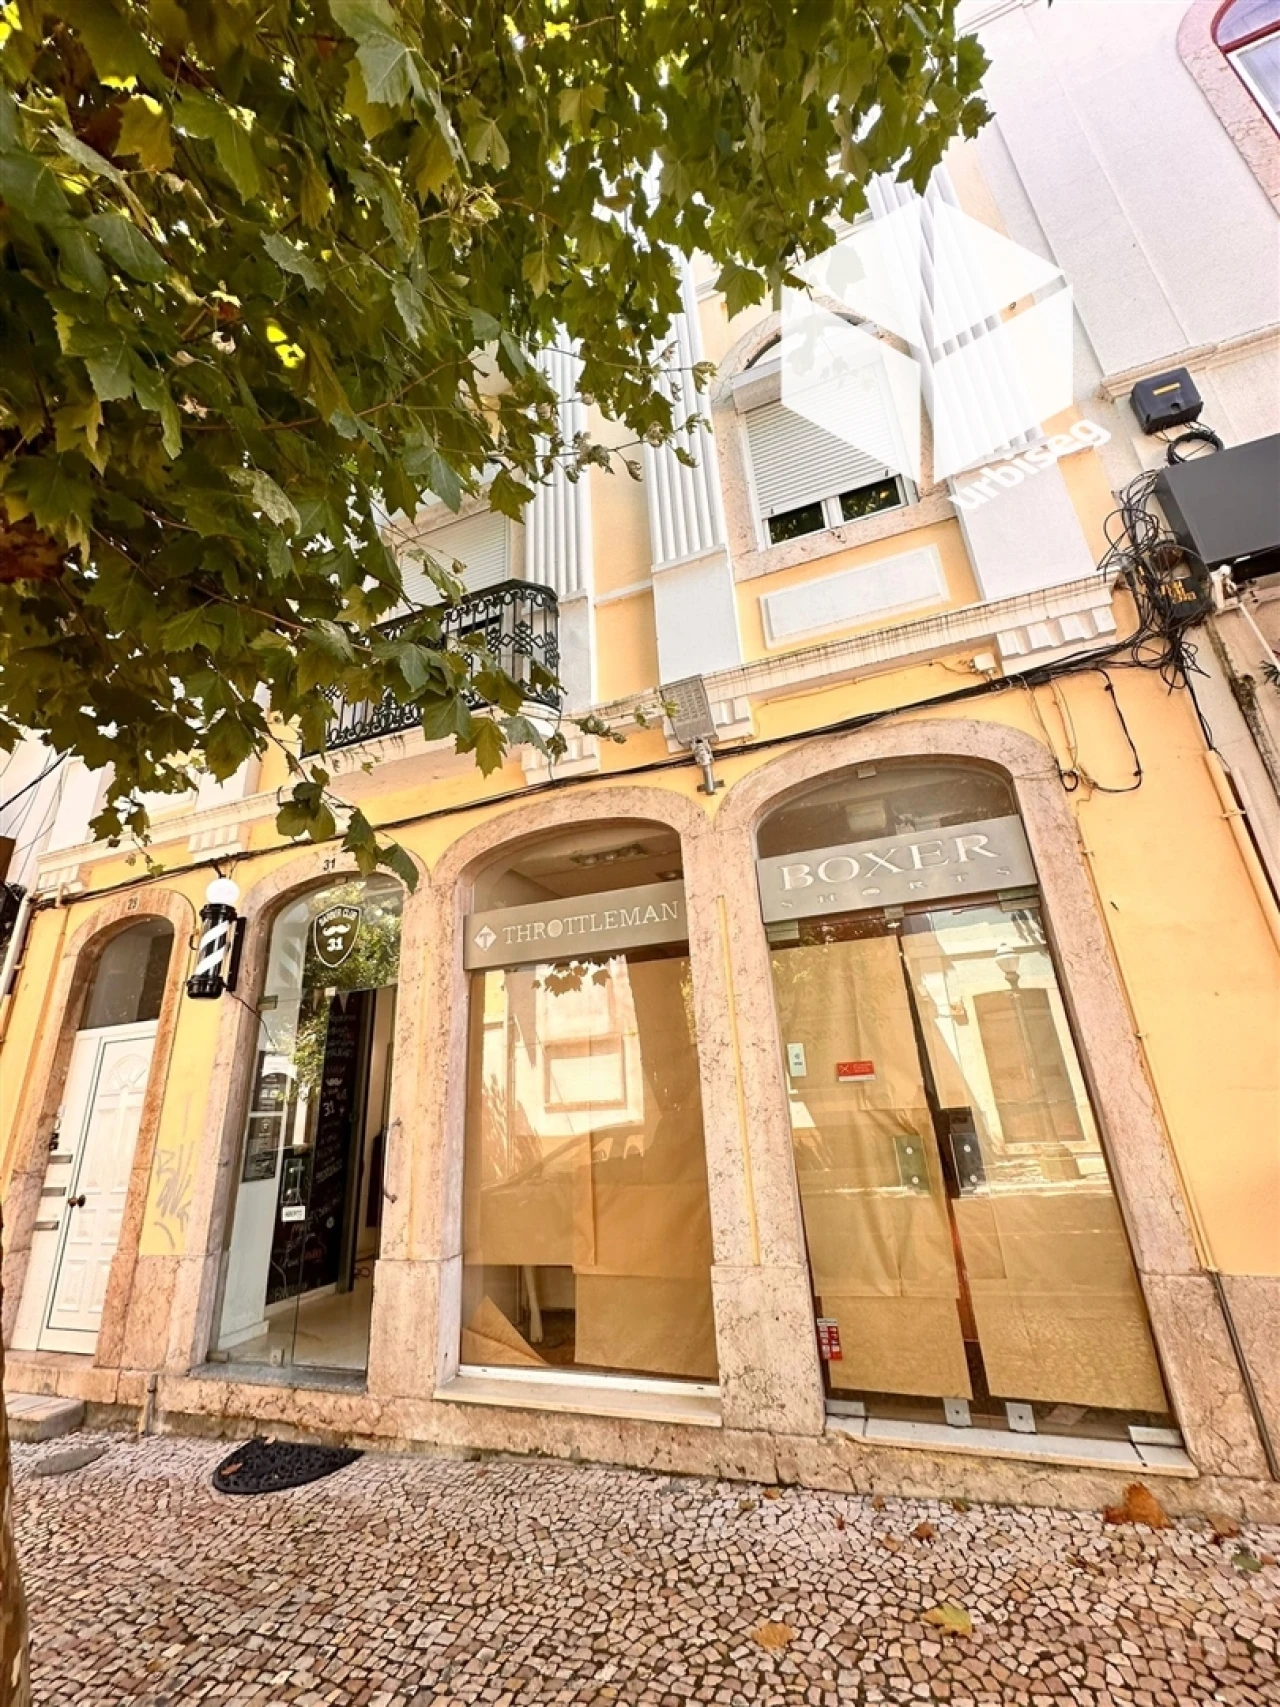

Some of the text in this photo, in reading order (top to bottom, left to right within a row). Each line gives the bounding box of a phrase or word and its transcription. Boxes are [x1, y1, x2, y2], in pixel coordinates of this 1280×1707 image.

[323, 857, 336, 871] 31
[780, 833, 1001, 891] BOXER
[502, 901, 679, 944] THROTTLEMAN
[326, 936, 344, 953] 31
